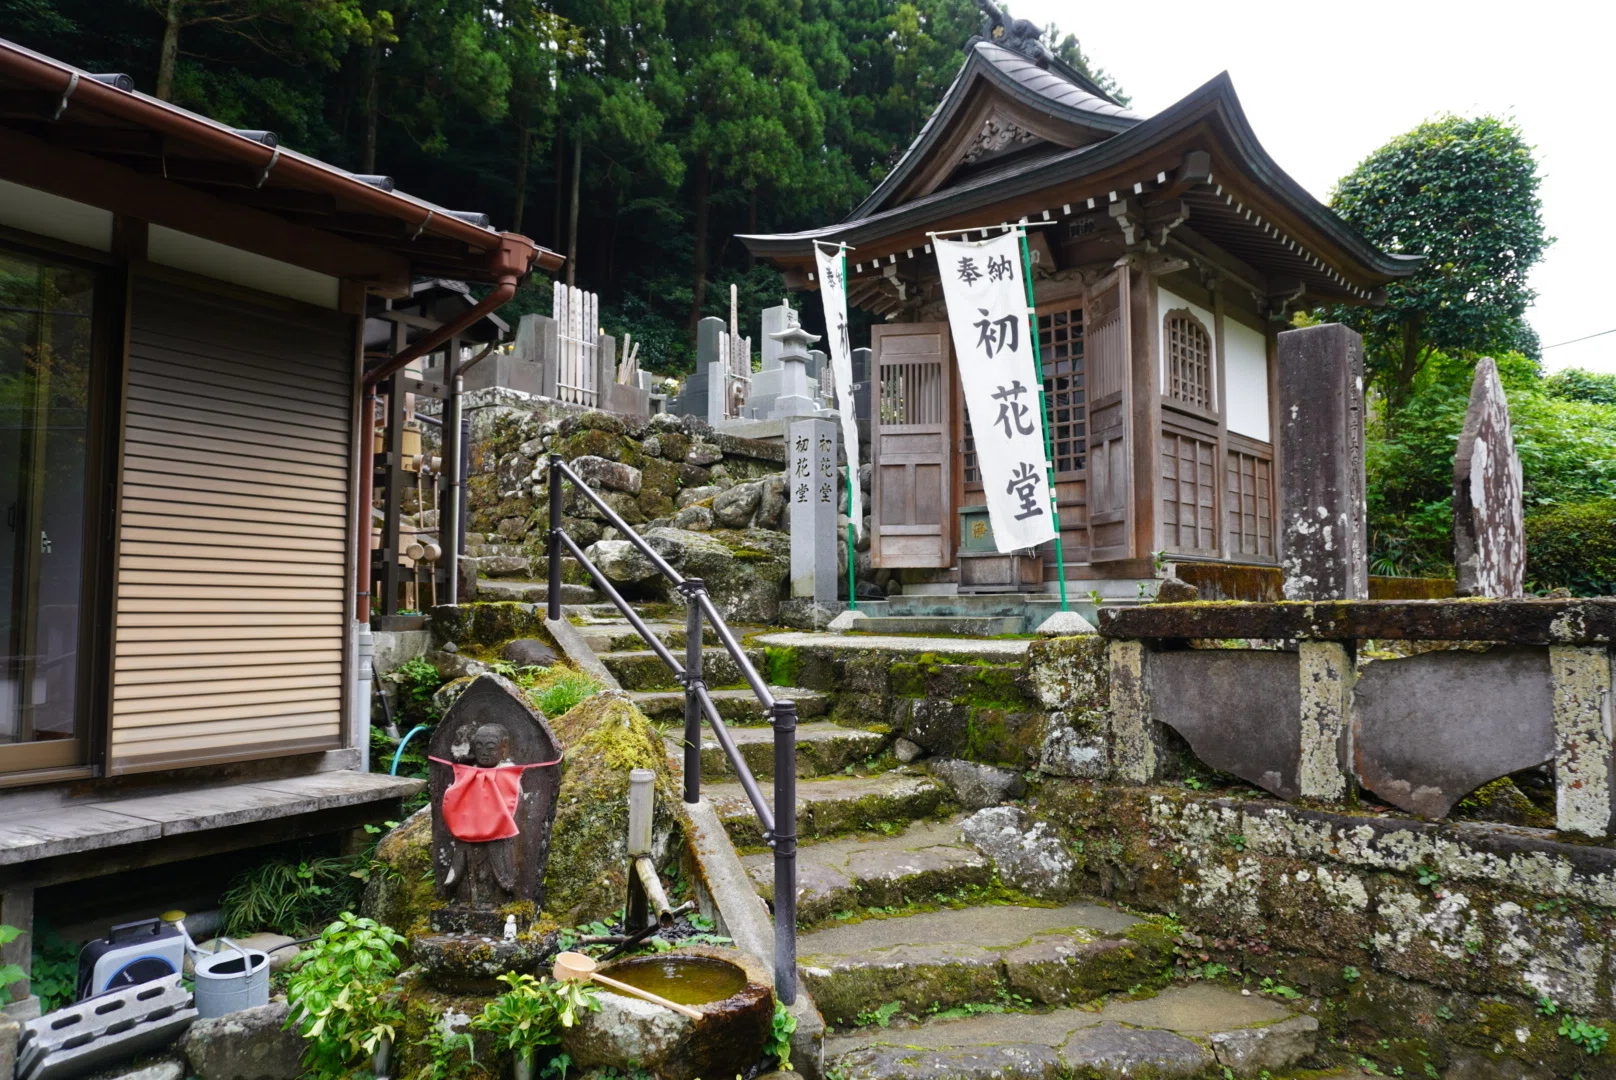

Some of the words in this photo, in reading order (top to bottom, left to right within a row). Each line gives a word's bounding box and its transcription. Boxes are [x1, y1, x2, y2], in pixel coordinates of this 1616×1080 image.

[957, 254, 1014, 288] 奉納
[972, 307, 1044, 521] 初花堂
[795, 435, 810, 503] 初花堂
[819, 434, 833, 503] 初花堂
